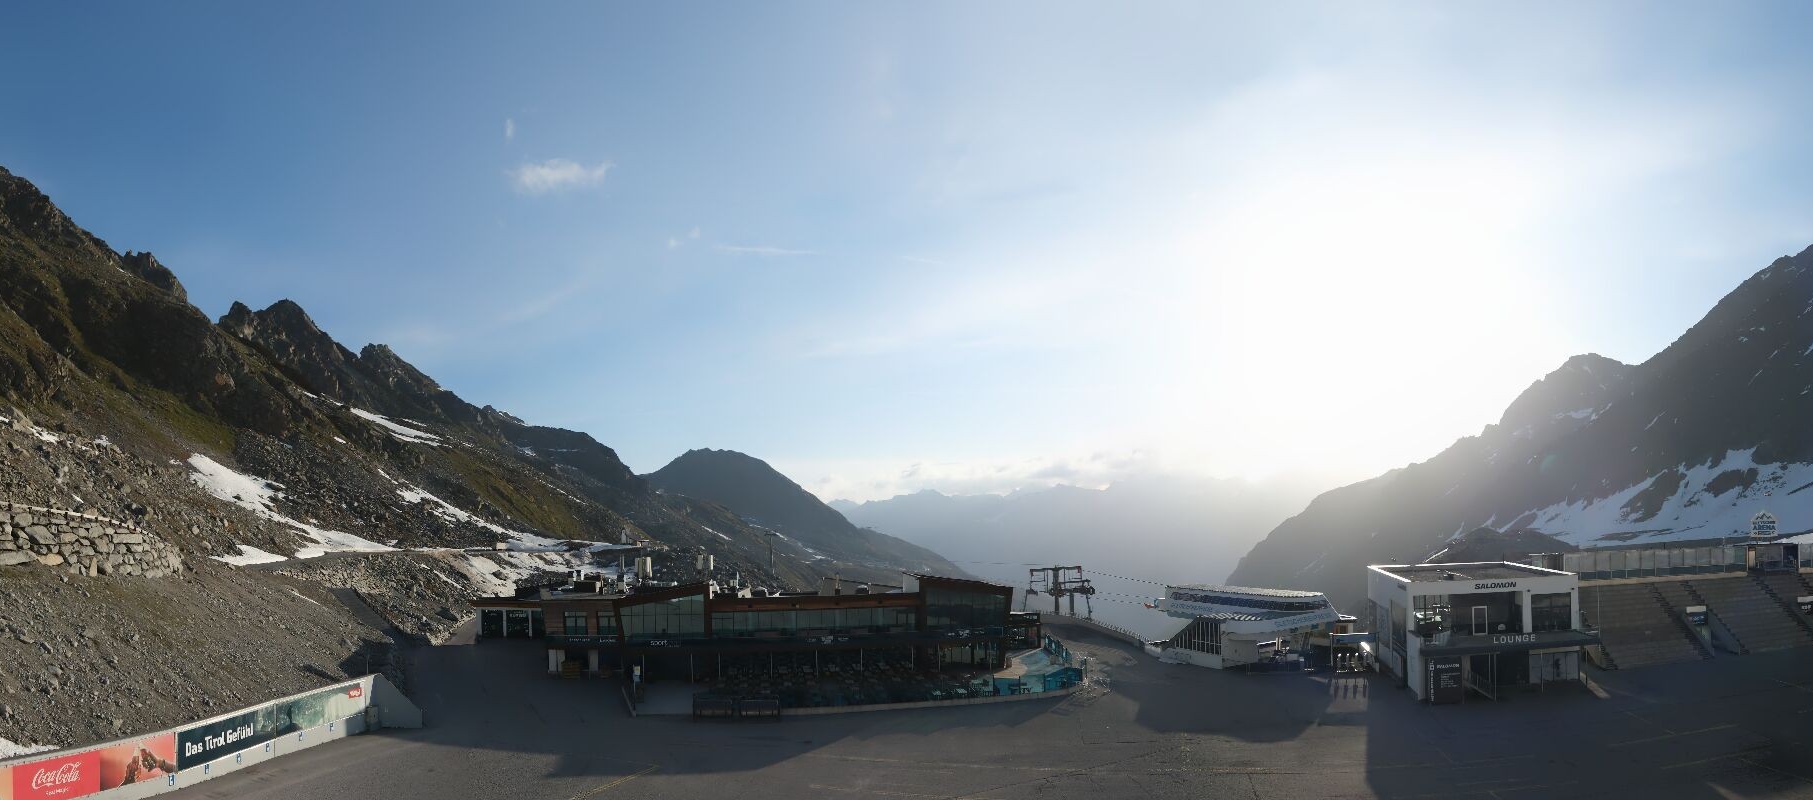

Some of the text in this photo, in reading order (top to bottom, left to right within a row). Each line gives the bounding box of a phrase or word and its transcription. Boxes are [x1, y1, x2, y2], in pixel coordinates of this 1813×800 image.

[1474, 581, 1517, 590] SALOMON
[1493, 634, 1537, 644] LOUNGE
[185, 723, 254, 757] Das Tirol Gefühl
